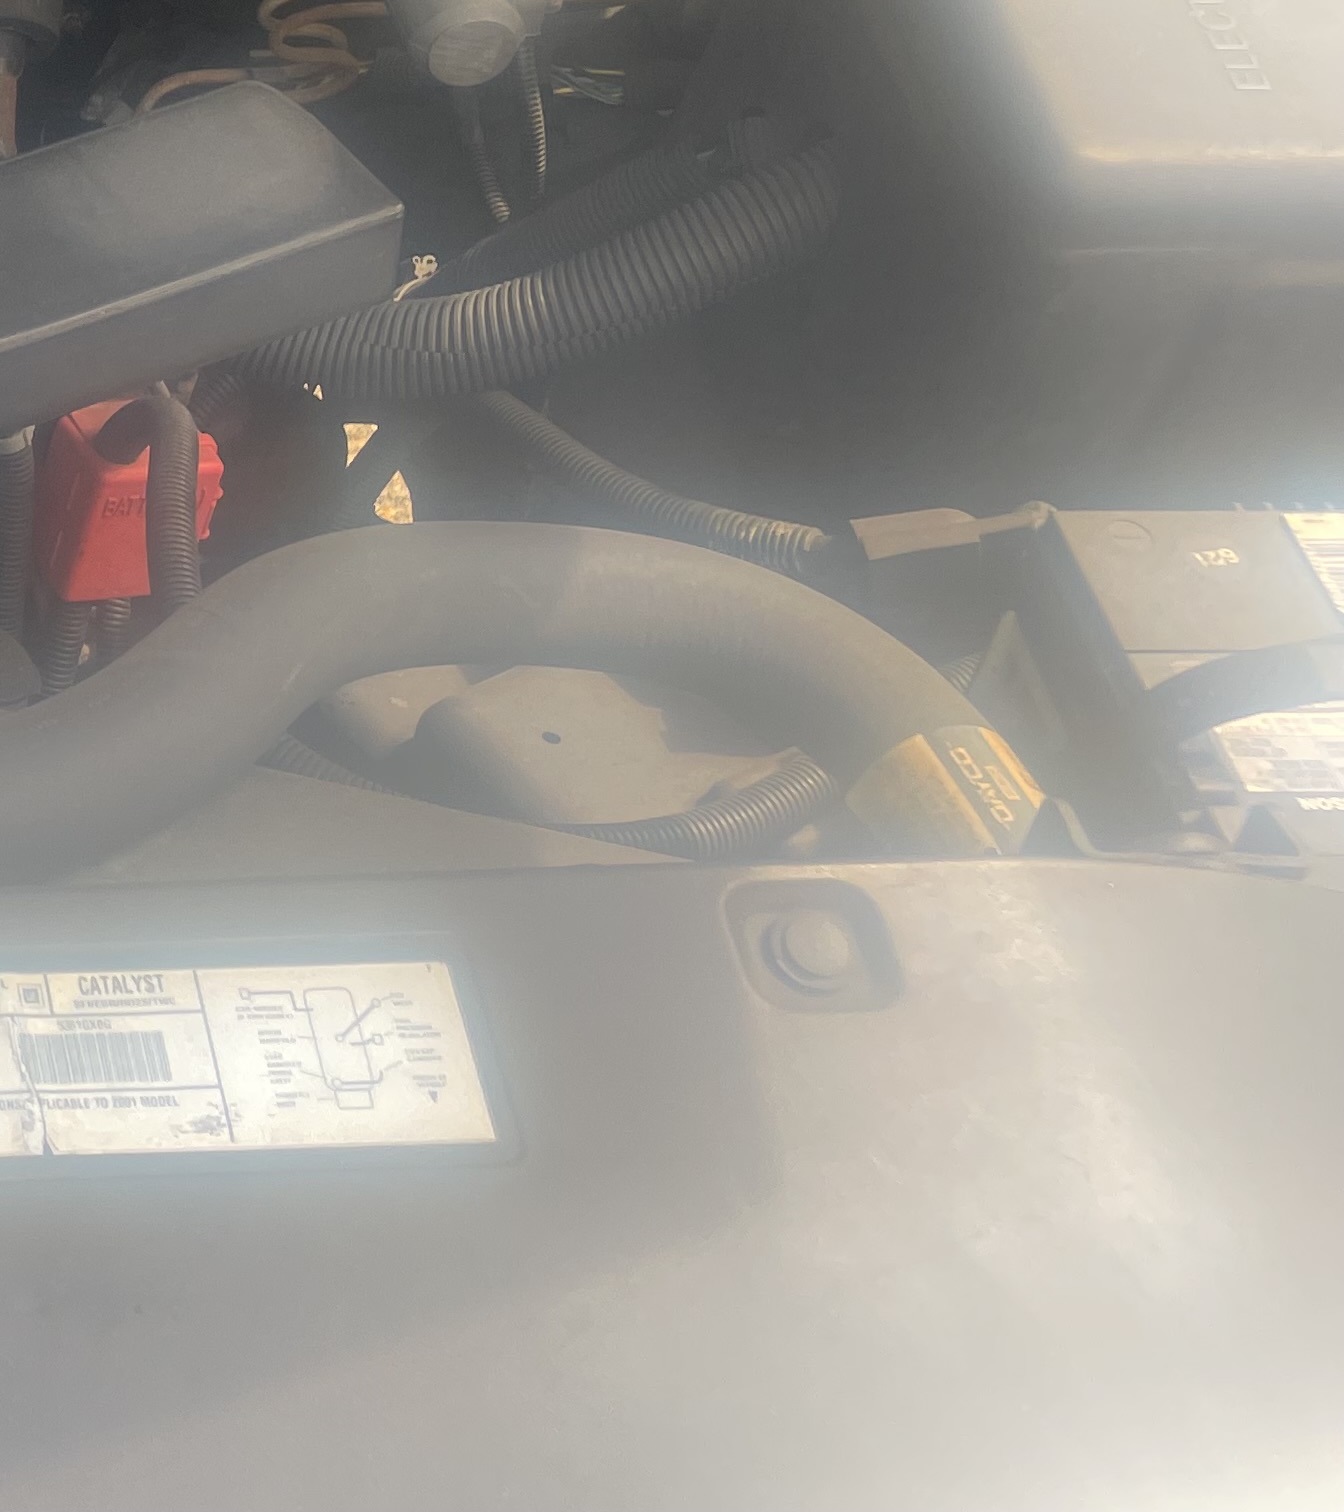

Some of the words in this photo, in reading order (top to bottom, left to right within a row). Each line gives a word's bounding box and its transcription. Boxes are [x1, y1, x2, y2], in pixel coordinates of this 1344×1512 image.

[77, 974, 166, 996] CATALYST
[94, 1096, 109, 1109] TO
[140, 1094, 180, 1108] MODEL
